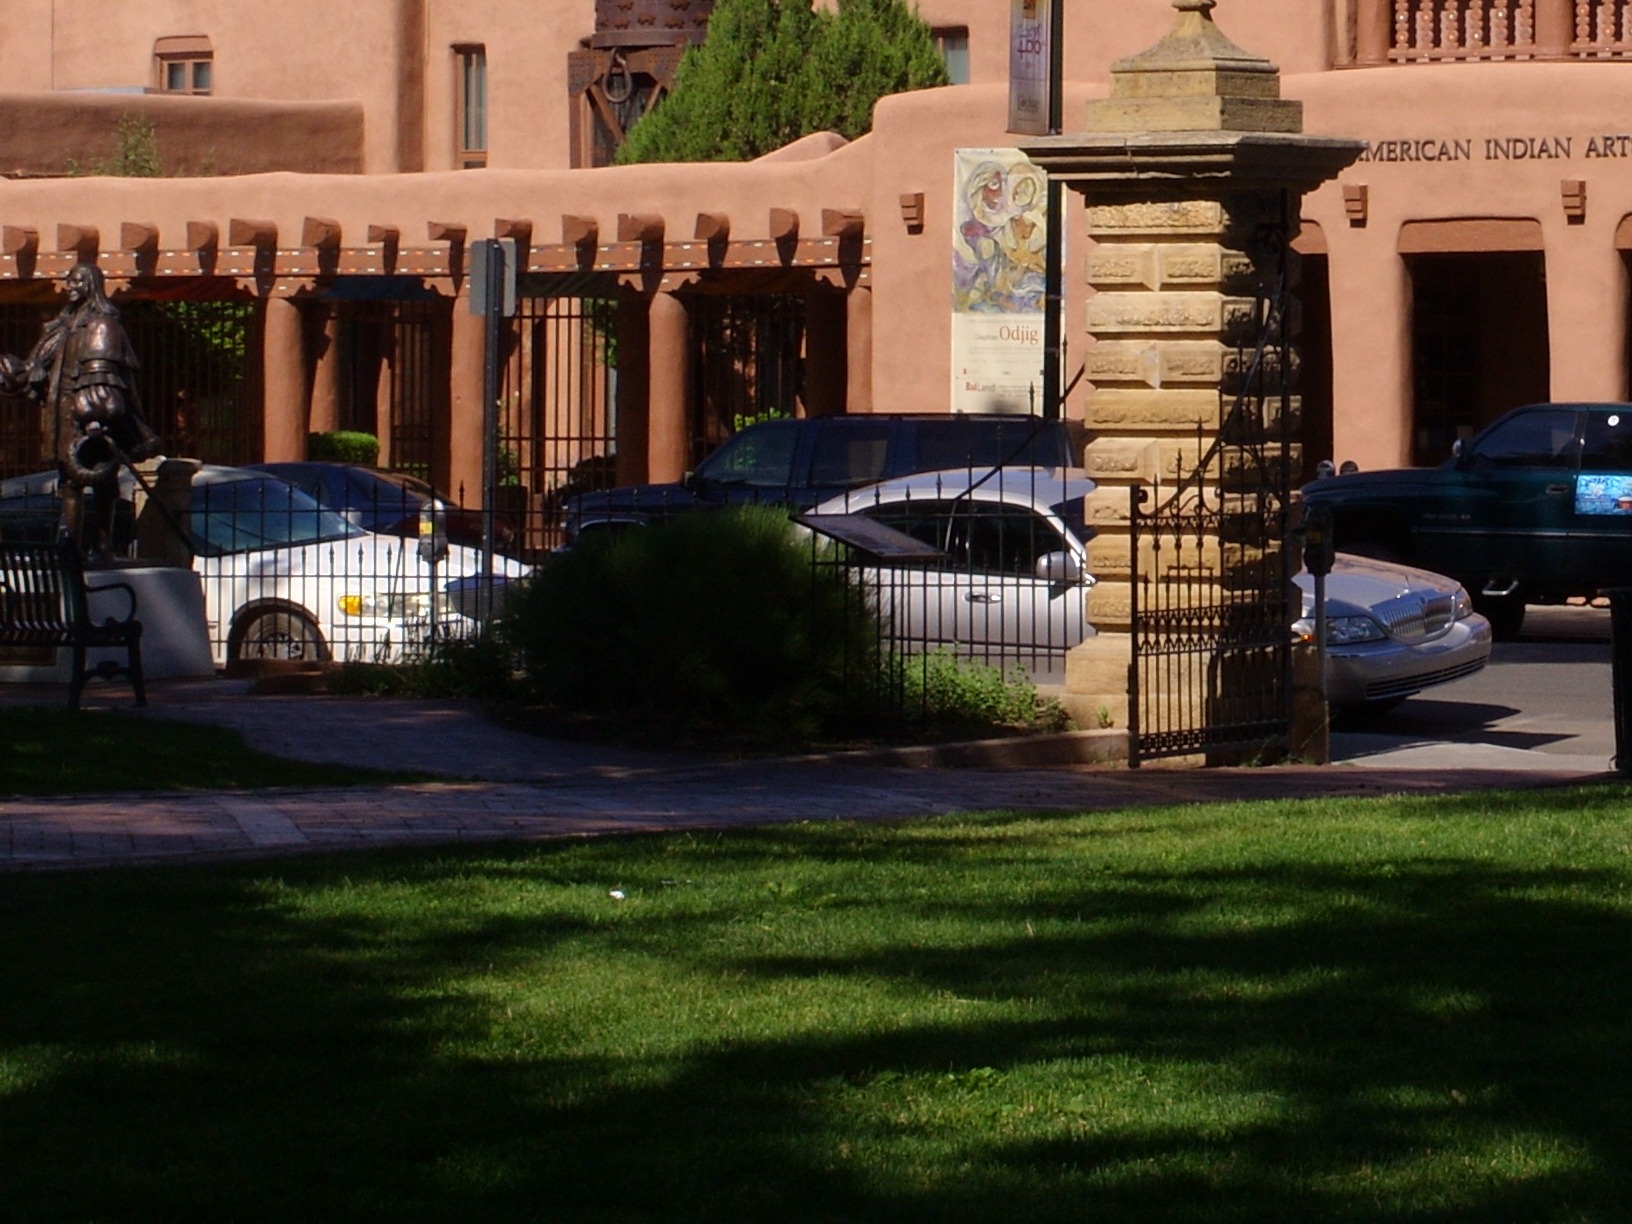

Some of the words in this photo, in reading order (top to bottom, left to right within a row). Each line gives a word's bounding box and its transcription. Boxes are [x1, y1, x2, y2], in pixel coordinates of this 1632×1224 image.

[1358, 139, 1472, 162] MERICAN
[1484, 136, 1573, 161] INDIAN
[999, 325, 1039, 346] Odjig
